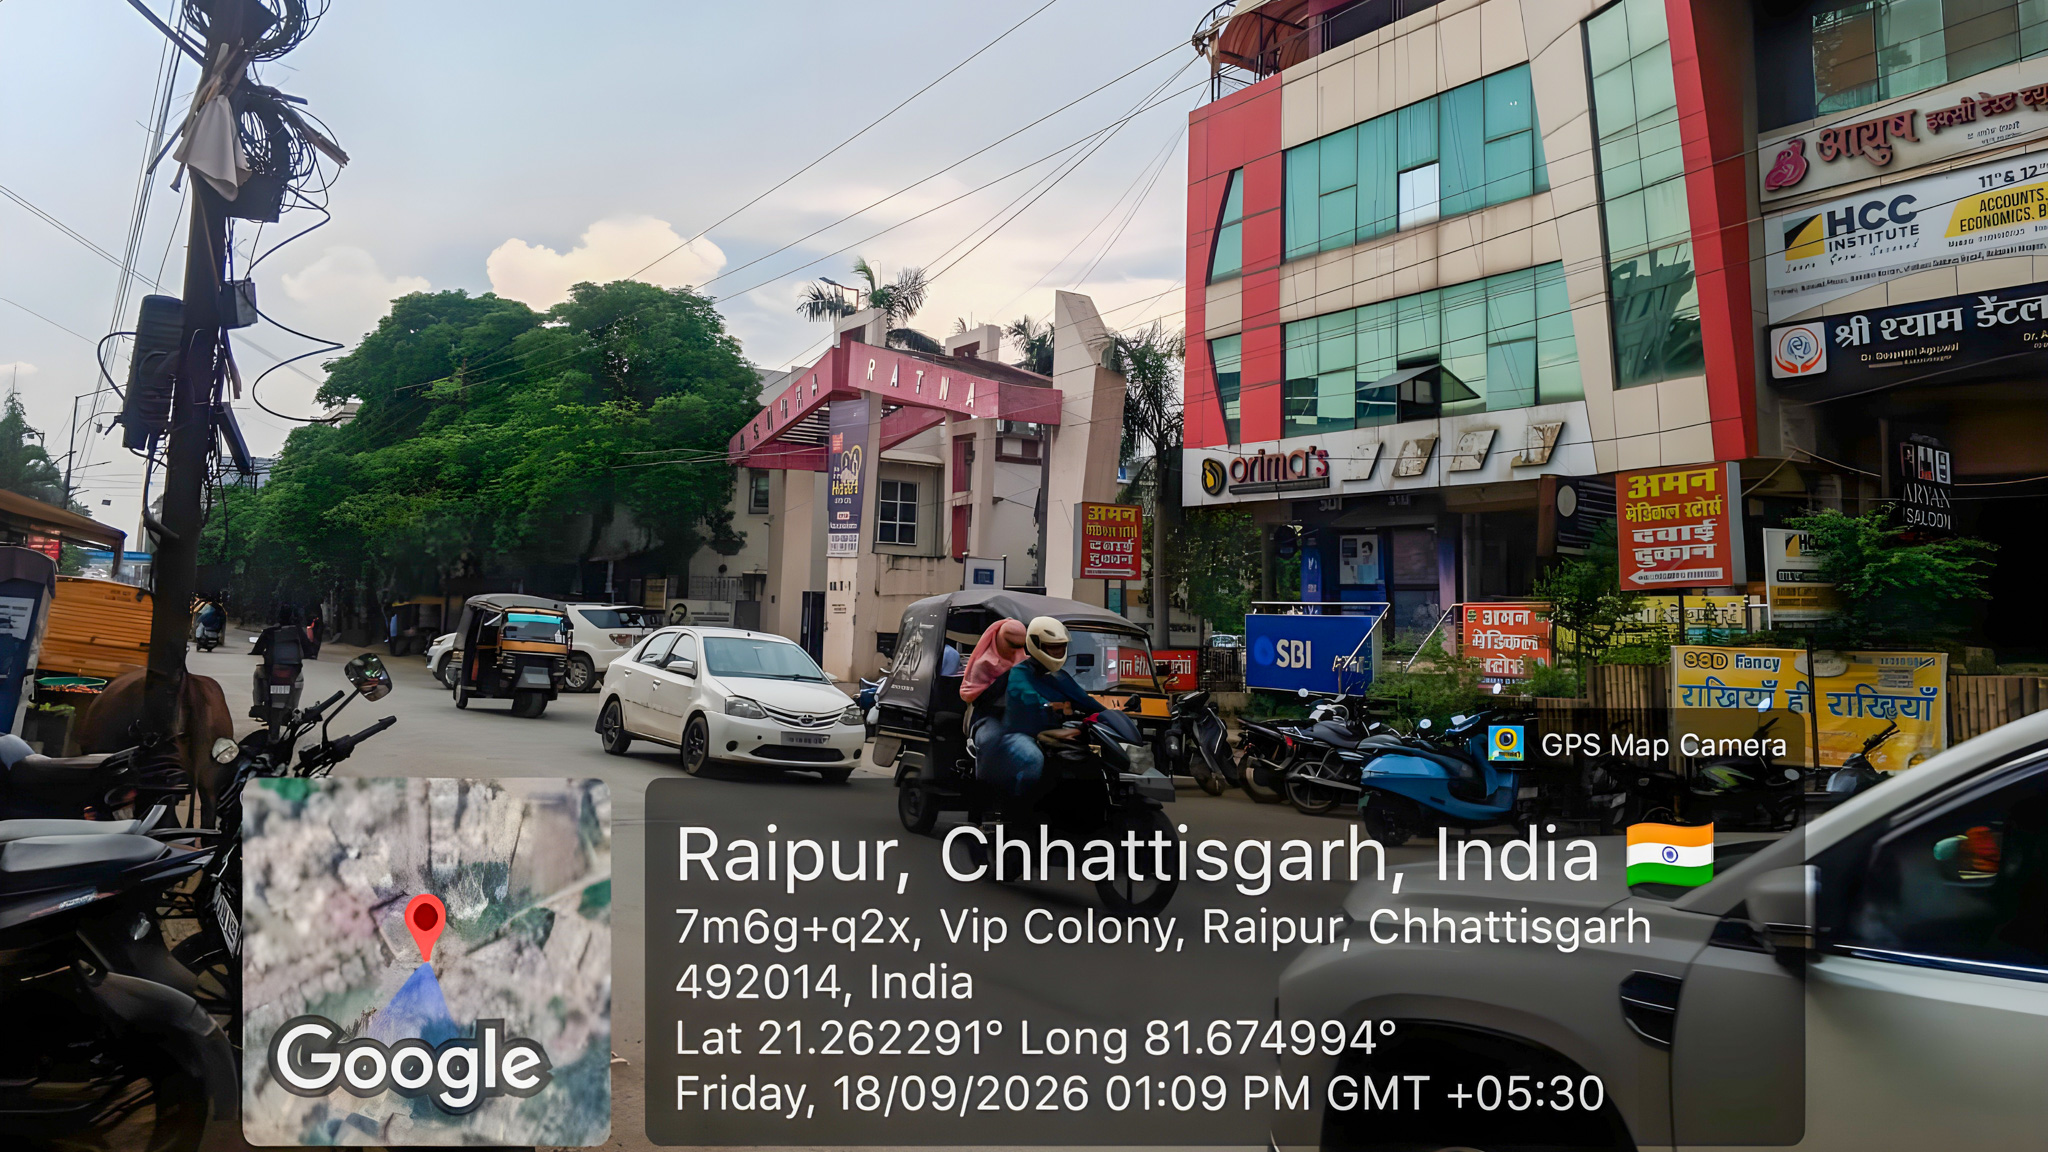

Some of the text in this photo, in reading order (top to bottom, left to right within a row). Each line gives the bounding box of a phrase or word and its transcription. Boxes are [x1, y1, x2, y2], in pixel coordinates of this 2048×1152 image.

[1816, 109, 1920, 167] आयुष
[2004, 170, 2015, 183] &
[1827, 194, 1918, 238] HCC
[2039, 203, 2048, 218] B
[1829, 224, 1920, 253] INSTITUTE
[1835, 315, 1871, 347] श्री
[1880, 307, 1963, 341] श्याम
[867, 358, 976, 408] RATNA
[1628, 468, 1718, 498] अमन
[1088, 506, 1138, 522] अमन
[1625, 494, 1722, 522] मेडिकल स्टोर्स
[1632, 518, 1718, 543] दवाई
[1632, 543, 1717, 568] दुकान
[1472, 628, 1540, 650] मेडिकल
[1276, 639, 1312, 669] SBI
[1678, 676, 1778, 710] राखियाँ
[1826, 683, 1938, 721] राखियाँ
